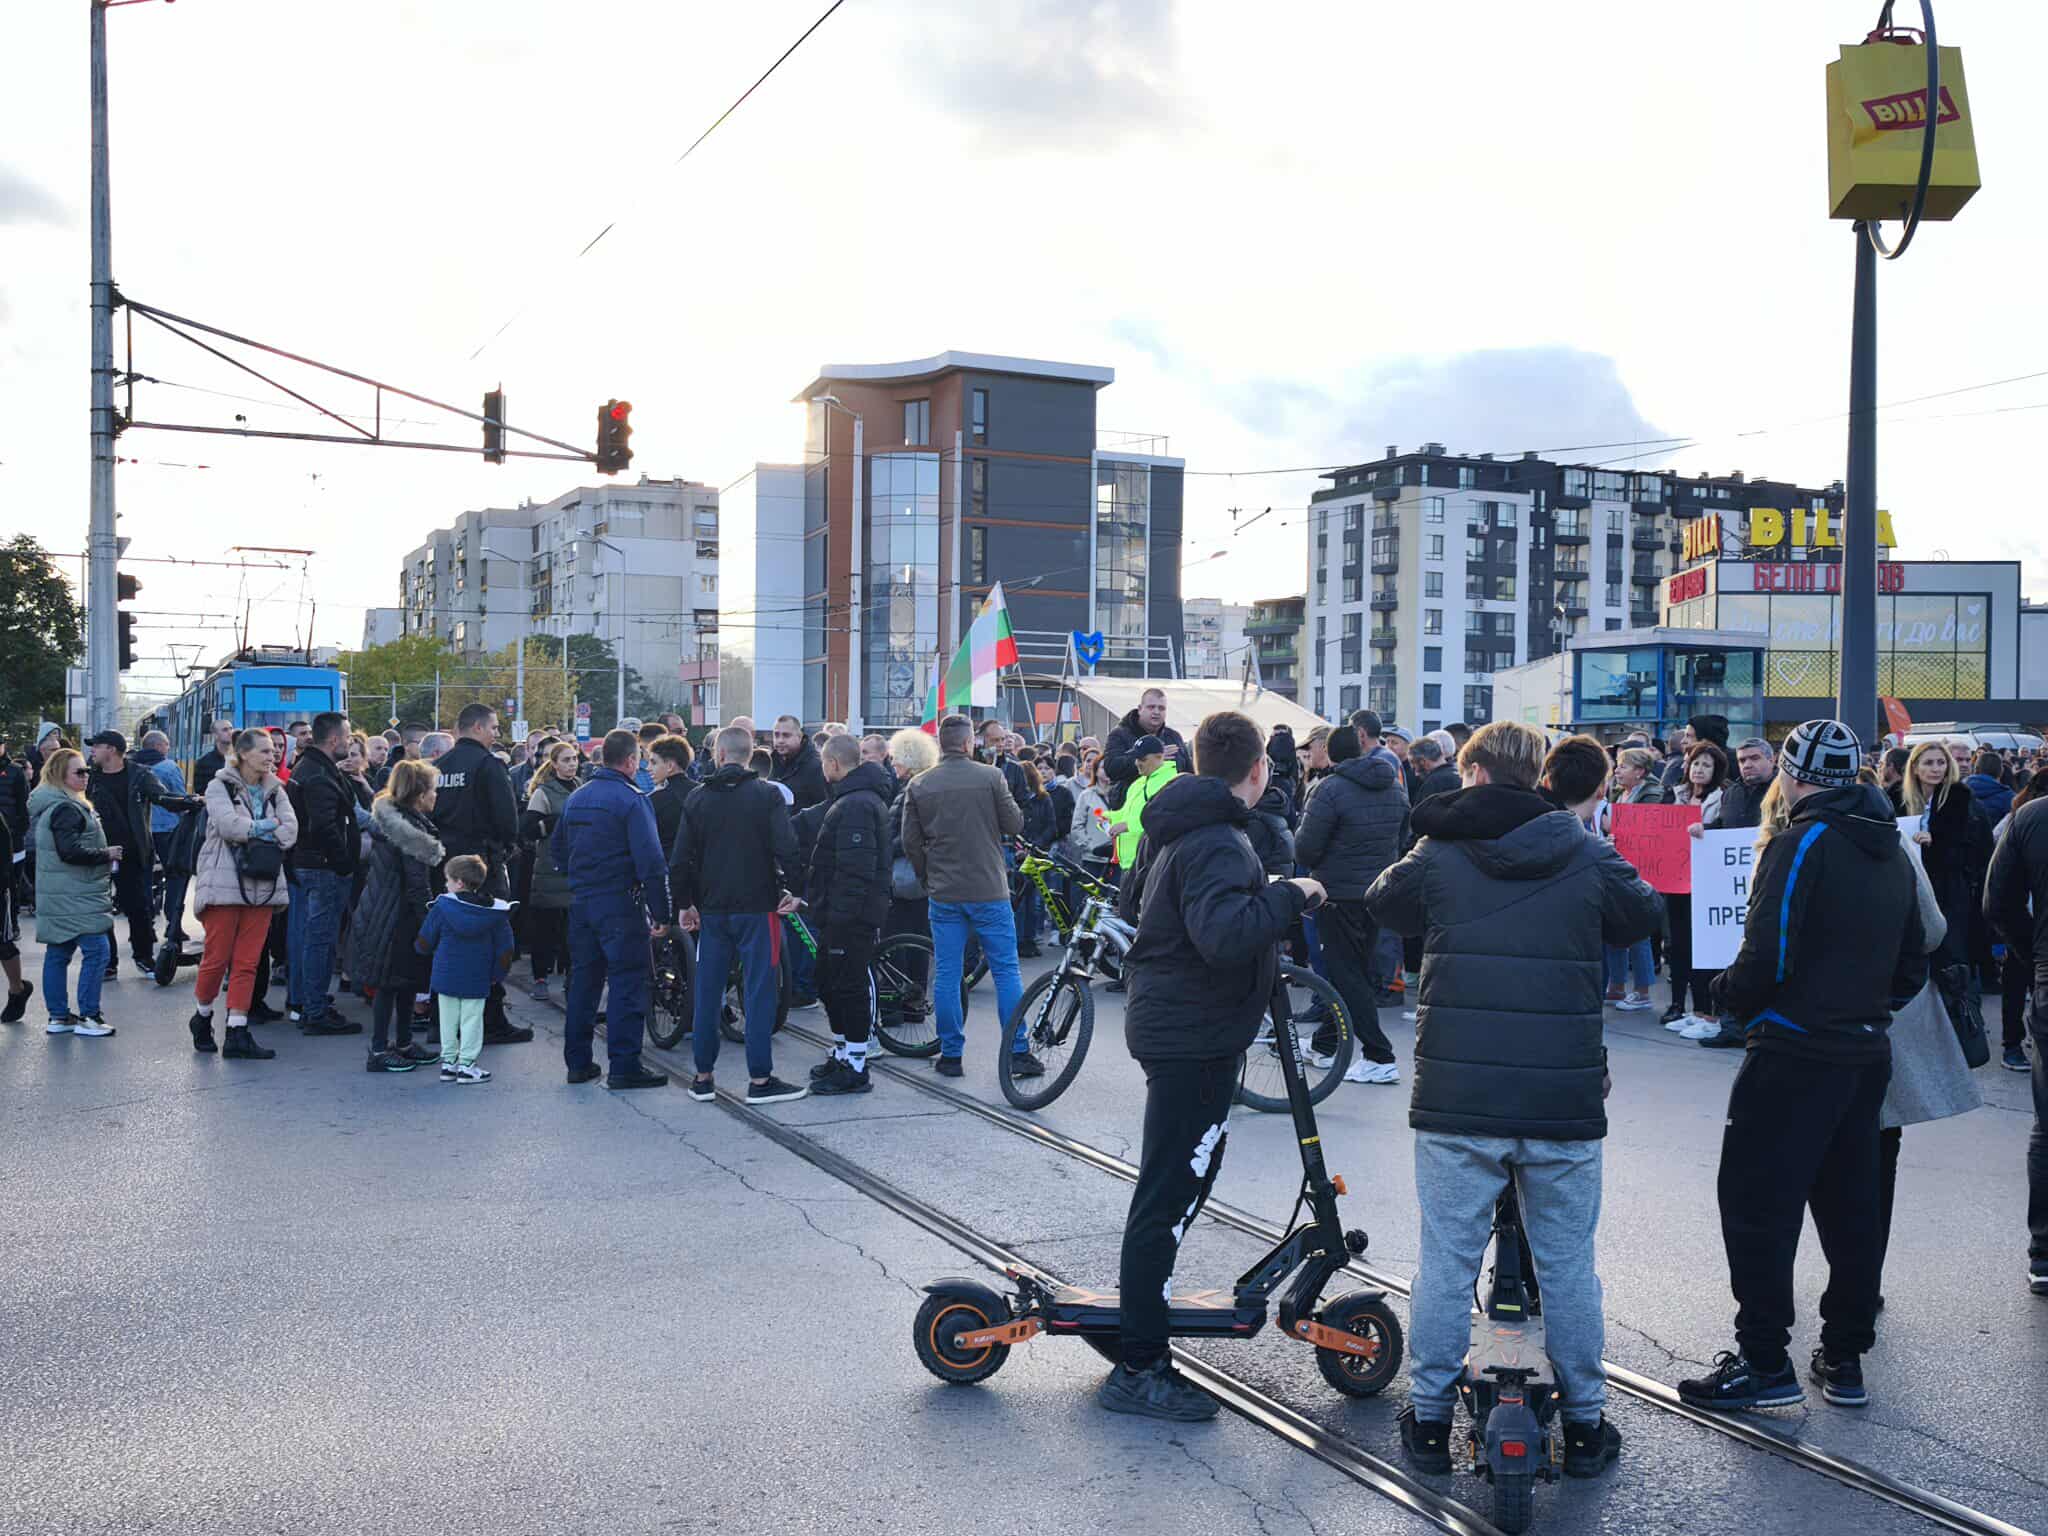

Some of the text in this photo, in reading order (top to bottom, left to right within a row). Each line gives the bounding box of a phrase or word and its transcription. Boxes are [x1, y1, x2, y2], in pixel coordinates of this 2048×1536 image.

[1749, 507, 1898, 548] BILA
[436, 772, 466, 788] OLICE
[1723, 846, 1755, 866] БЕ
[1733, 876, 1747, 895] Н
[1708, 906, 1747, 926] ПРЕ
